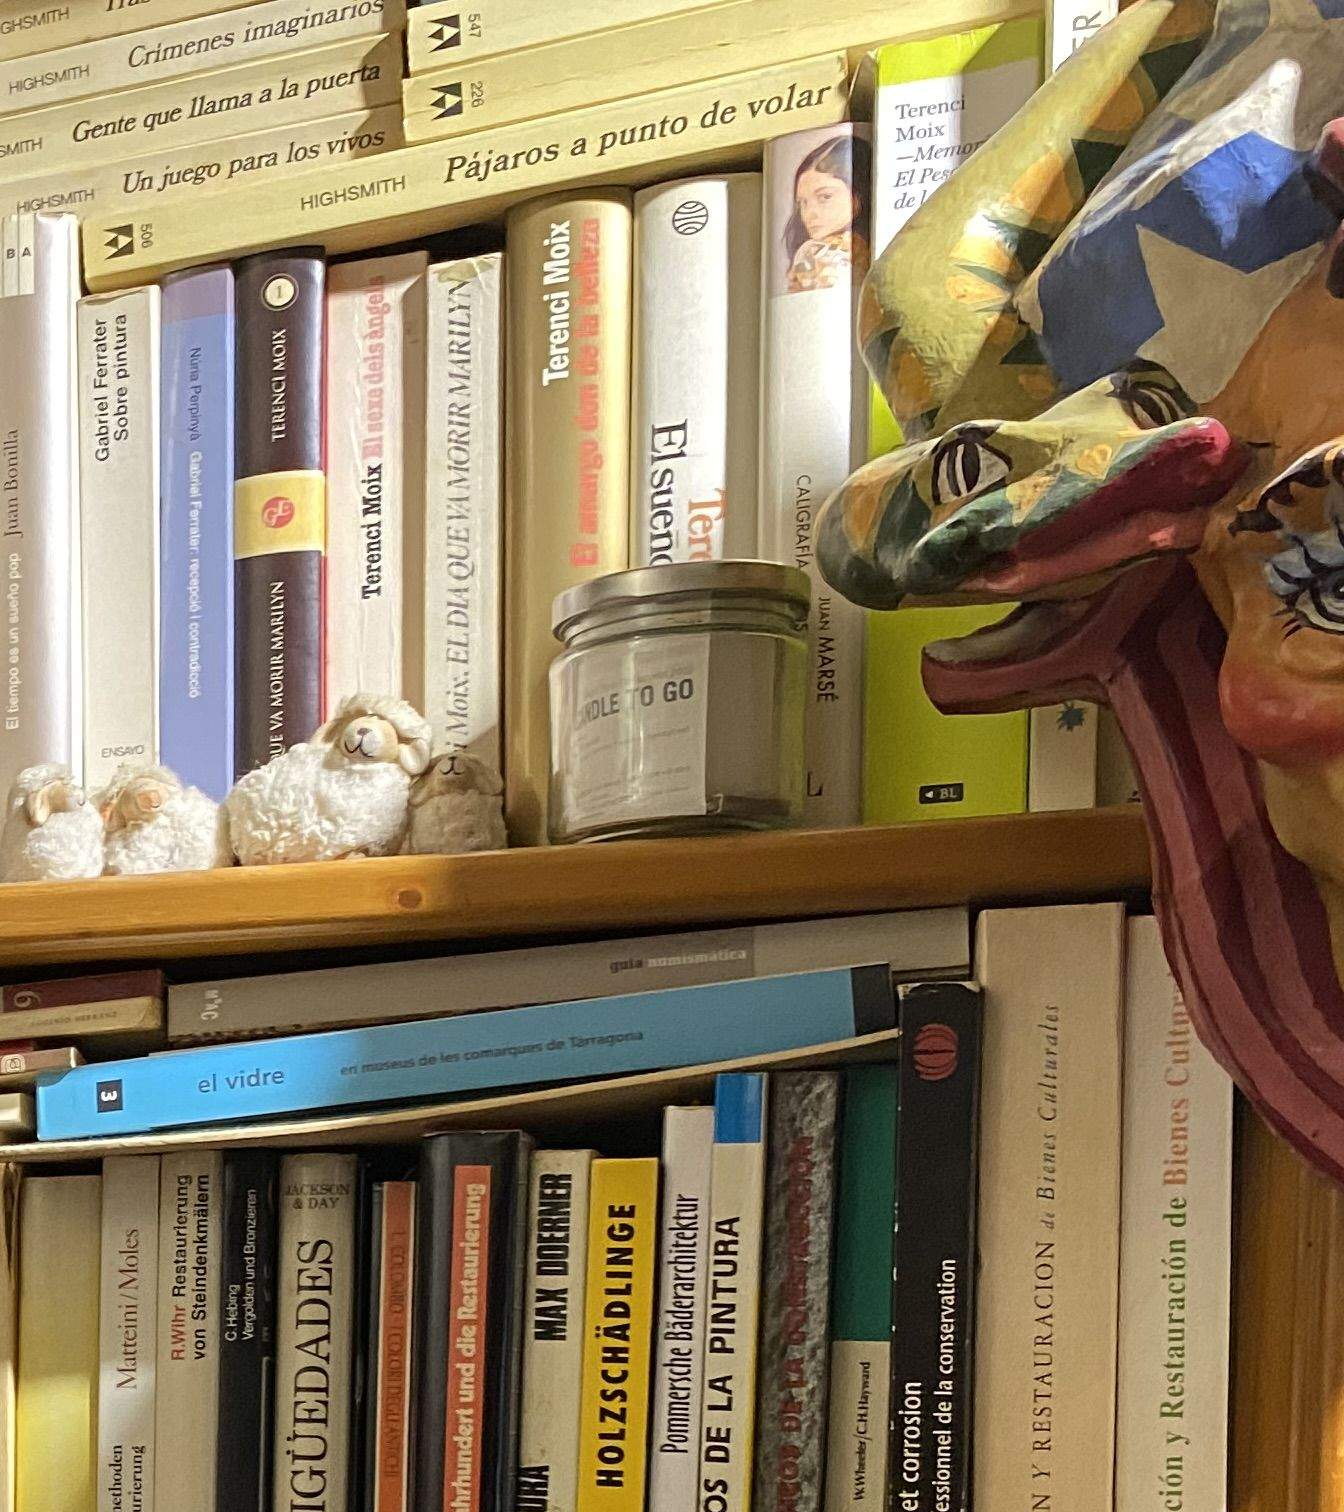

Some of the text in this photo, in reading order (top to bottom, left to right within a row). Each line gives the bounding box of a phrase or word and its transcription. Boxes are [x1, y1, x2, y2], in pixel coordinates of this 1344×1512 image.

[17, 128, 386, 212] HIGHSMITH Un juego para los vivos
[443, 142, 559, 184] Pájaros
[570, 137, 587, 157] a
[598, 114, 688, 156] punto
[748, 81, 832, 121] volar
[139, 176, 407, 248] 506 HIGHSMITH
[542, 219, 571, 386] Terenci Moix
[94, 319, 109, 462] Gabriel Ferrater
[114, 315, 131, 440] Sobre pintura
[363, 464, 383, 600] Terenci Moix
[662, 678, 694, 702] GO
[818, 597, 836, 703] JUAN MARSÉ
[198, 1068, 285, 1092] el vidre
[1038, 1004, 1060, 1123] Culturales
[1037, 1129, 1054, 1199] Bienes
[117, 1228, 138, 1390] Matteini/Moles
[711, 1215, 740, 1353] PINTURA
[597, 1204, 637, 1488] HOLZSCHÄDLINGE
[709, 1359, 734, 1412] LA
[1032, 1241, 1054, 1450] RESTAURACION
[705, 1423, 731, 1467] DE
[901, 1381, 922, 1509] et corrosion
[1033, 1465, 1051, 1479] Y
